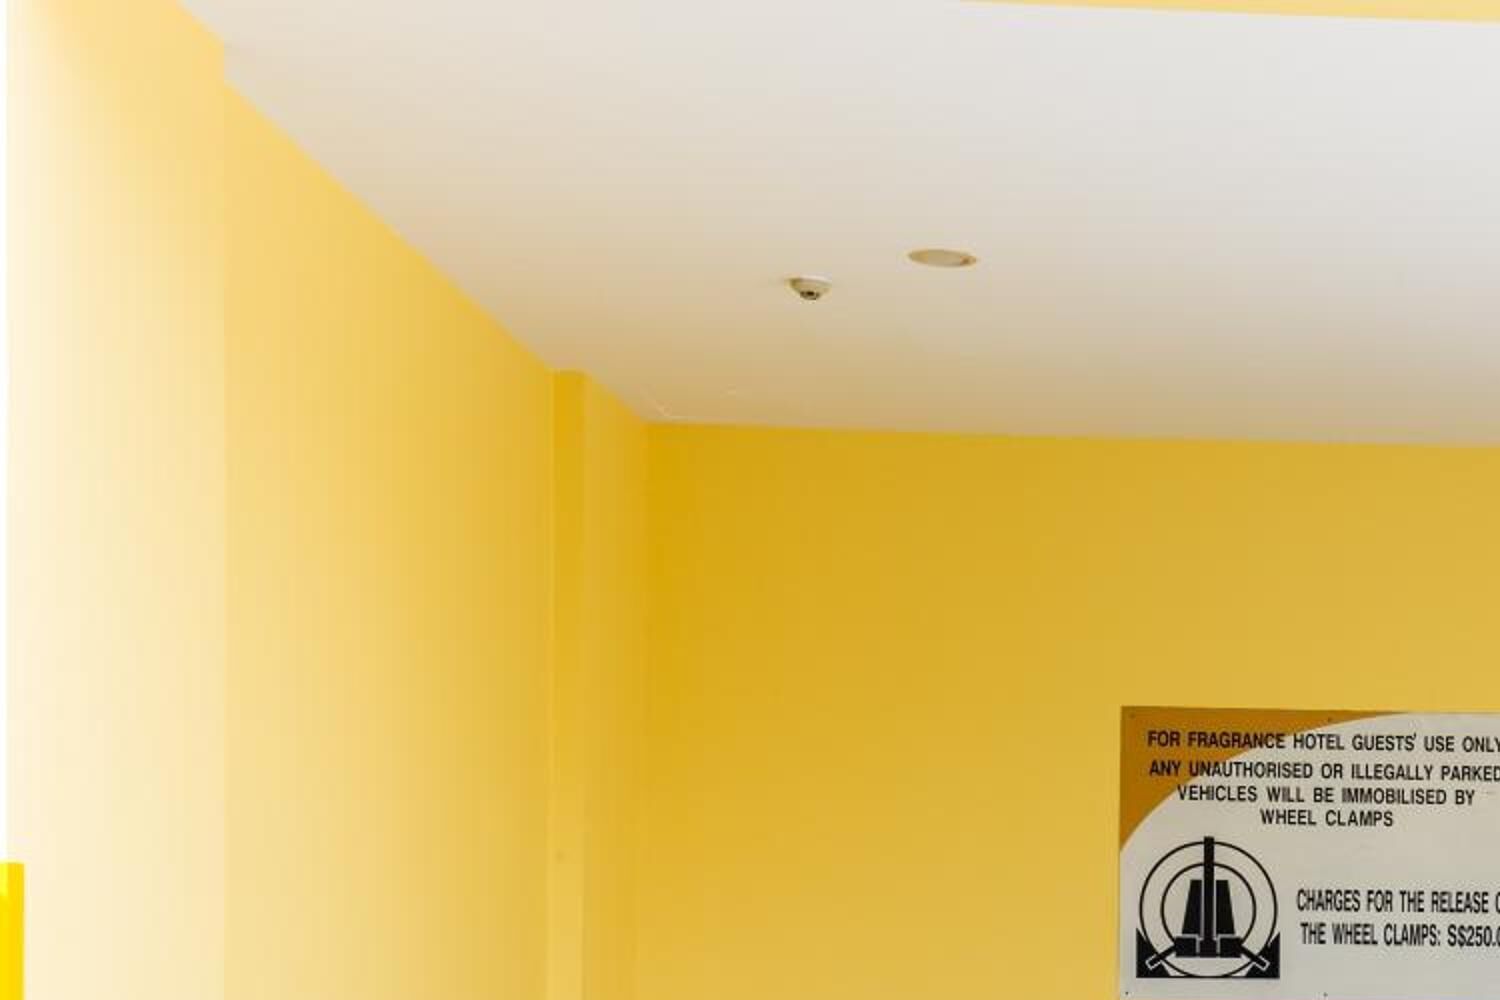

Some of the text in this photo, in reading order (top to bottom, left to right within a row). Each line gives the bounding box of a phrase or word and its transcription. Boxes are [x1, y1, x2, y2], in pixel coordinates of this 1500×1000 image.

[1148, 731, 1180, 747] FOR
[1187, 731, 1286, 749] FRAGRANCE
[1293, 733, 1345, 750] HOTEL
[1424, 736, 1455, 751] USE
[1149, 760, 1181, 776] ANY
[1188, 761, 1313, 779] UNAUTHORISED
[1321, 763, 1343, 779] OR
[1351, 764, 1433, 780] ILLEGALLY
[1177, 785, 1475, 805] VEHICLES WILL BE IMMOBILISED BY
[1260, 809, 1393, 826] WHEEL CLAMPS
[1296, 889, 1361, 912] CHARGES
[1367, 890, 1393, 912] FOR
[1400, 890, 1425, 913] THE
[1431, 891, 1489, 913] RELEASE
[1300, 922, 1326, 945] THE
[1331, 922, 1378, 945] WHEEL
[1383, 923, 1441, 946] CLAMPS:
